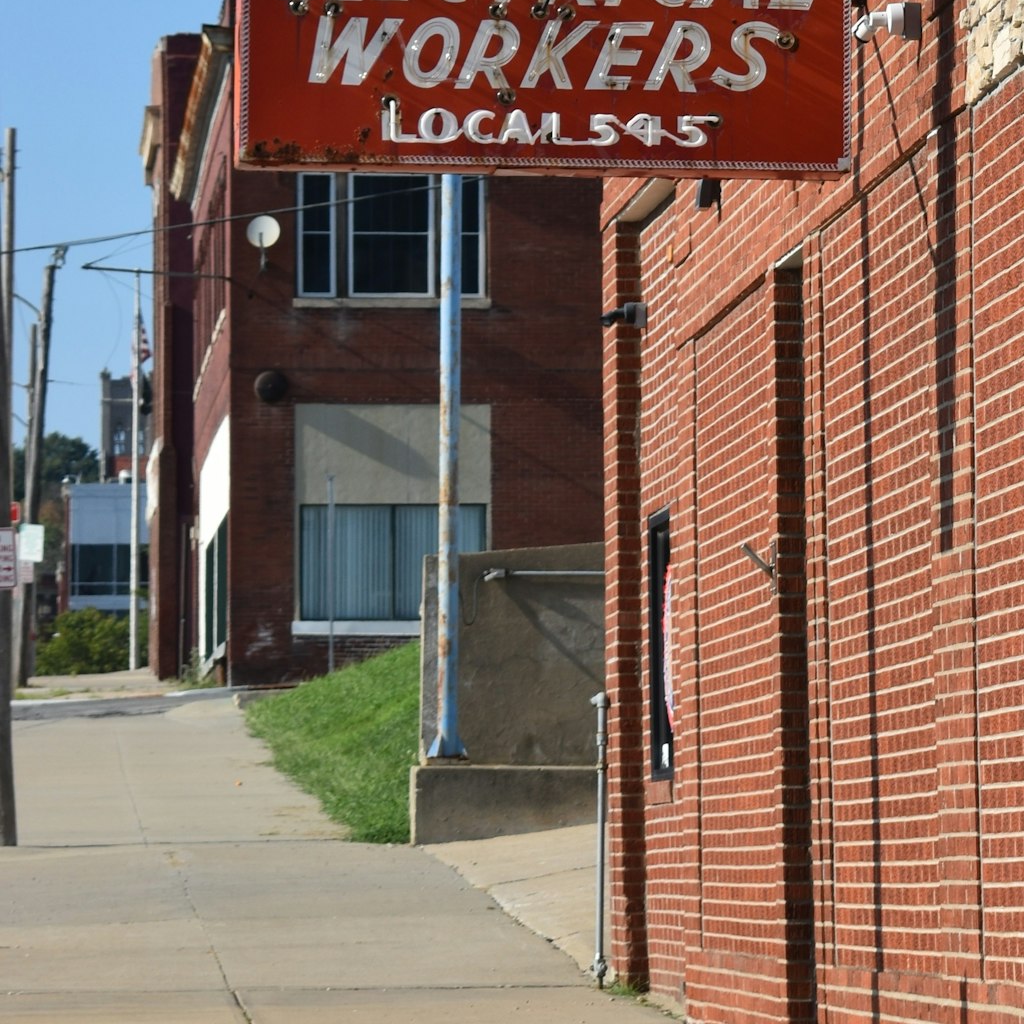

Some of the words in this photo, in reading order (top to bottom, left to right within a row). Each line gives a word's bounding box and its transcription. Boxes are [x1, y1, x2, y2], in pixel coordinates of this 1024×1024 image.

[307, 16, 784, 94] WORKERS
[381, 106, 573, 146] LOCAL
[593, 113, 712, 148] 545
